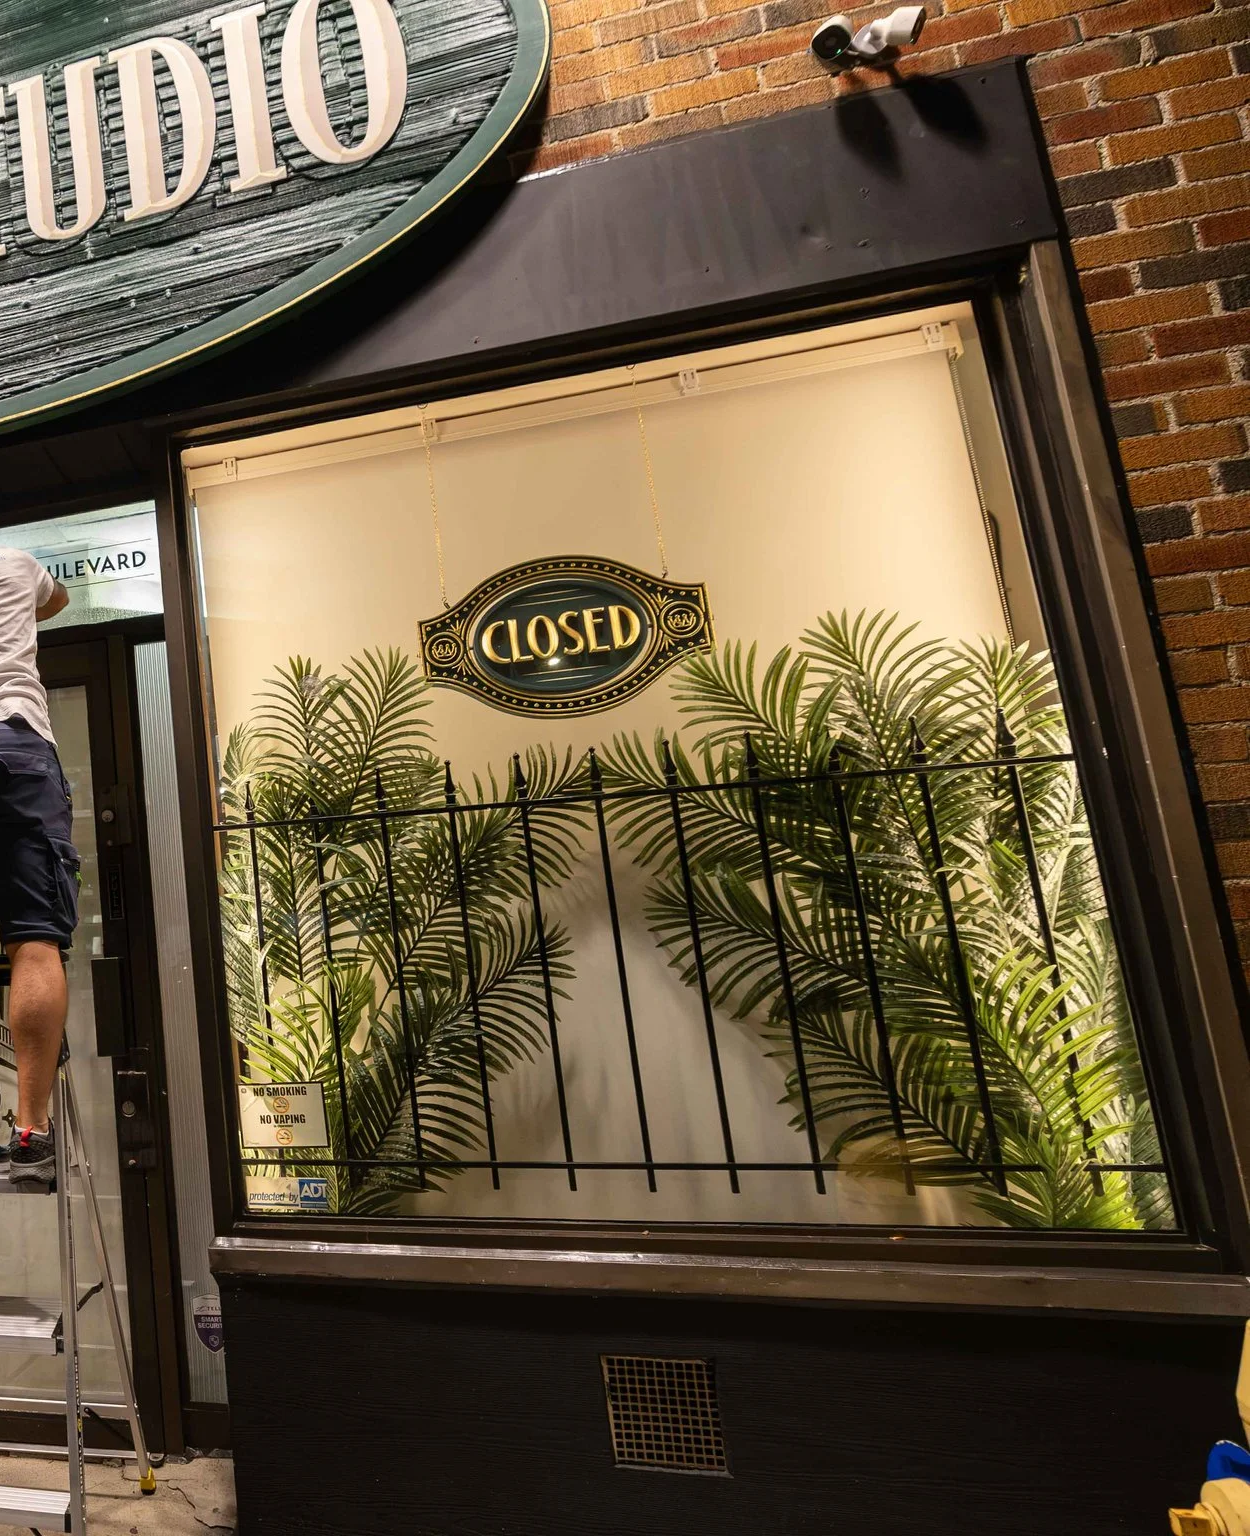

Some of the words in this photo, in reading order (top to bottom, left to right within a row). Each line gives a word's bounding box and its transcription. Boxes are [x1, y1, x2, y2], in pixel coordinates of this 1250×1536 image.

[47, 551, 146, 580] ULEVARD
[481, 604, 641, 664] CLOSED
[253, 1087, 265, 1097] NO
[266, 1086, 307, 1097] SMOKING
[259, 1114, 272, 1125] NO
[273, 1113, 306, 1125] VAPING
[249, 1192, 285, 1203] protected
[288, 1191, 299, 1204] by
[301, 1183, 328, 1198] ADT
